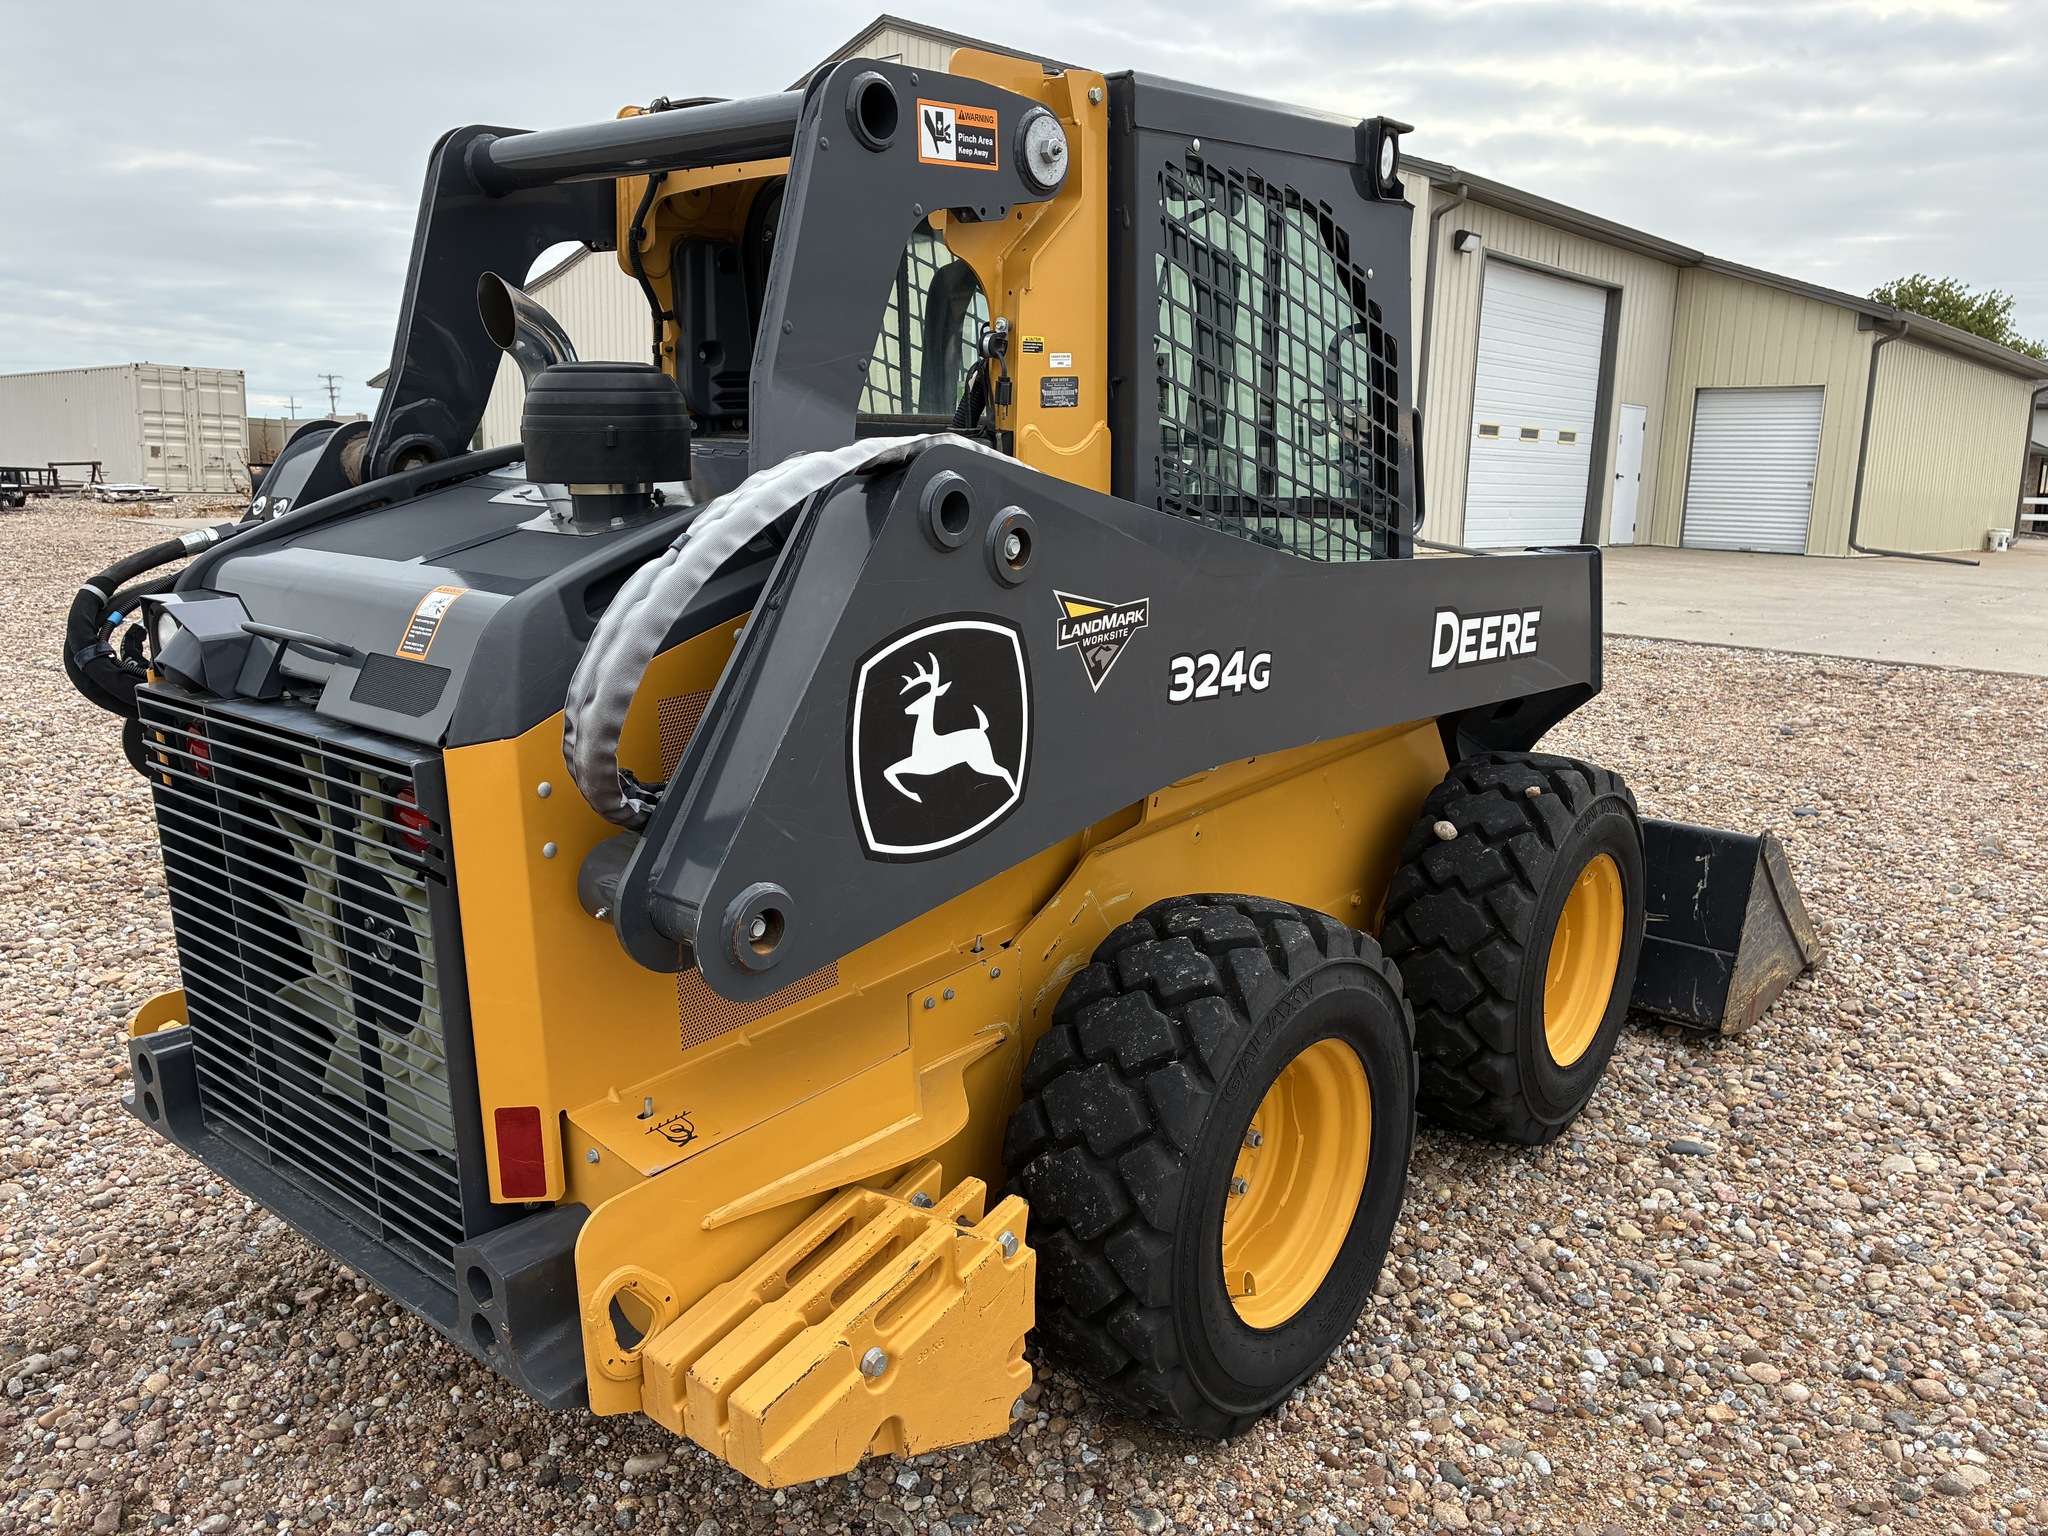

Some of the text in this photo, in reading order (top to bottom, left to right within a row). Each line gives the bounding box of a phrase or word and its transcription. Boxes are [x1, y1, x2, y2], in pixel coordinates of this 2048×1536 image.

[964, 114, 994, 124] WARNING
[958, 132, 994, 146] Pinch Area
[958, 146, 989, 159] Keep Away
[1082, 628, 1129, 647] WORKSITE
[1431, 609, 1541, 669] DEERE
[1169, 650, 1271, 702] 324G
[1575, 801, 1623, 835] GALAXY
[1221, 976, 1314, 1102] GALAXY
[761, 1271, 780, 1291] USA
